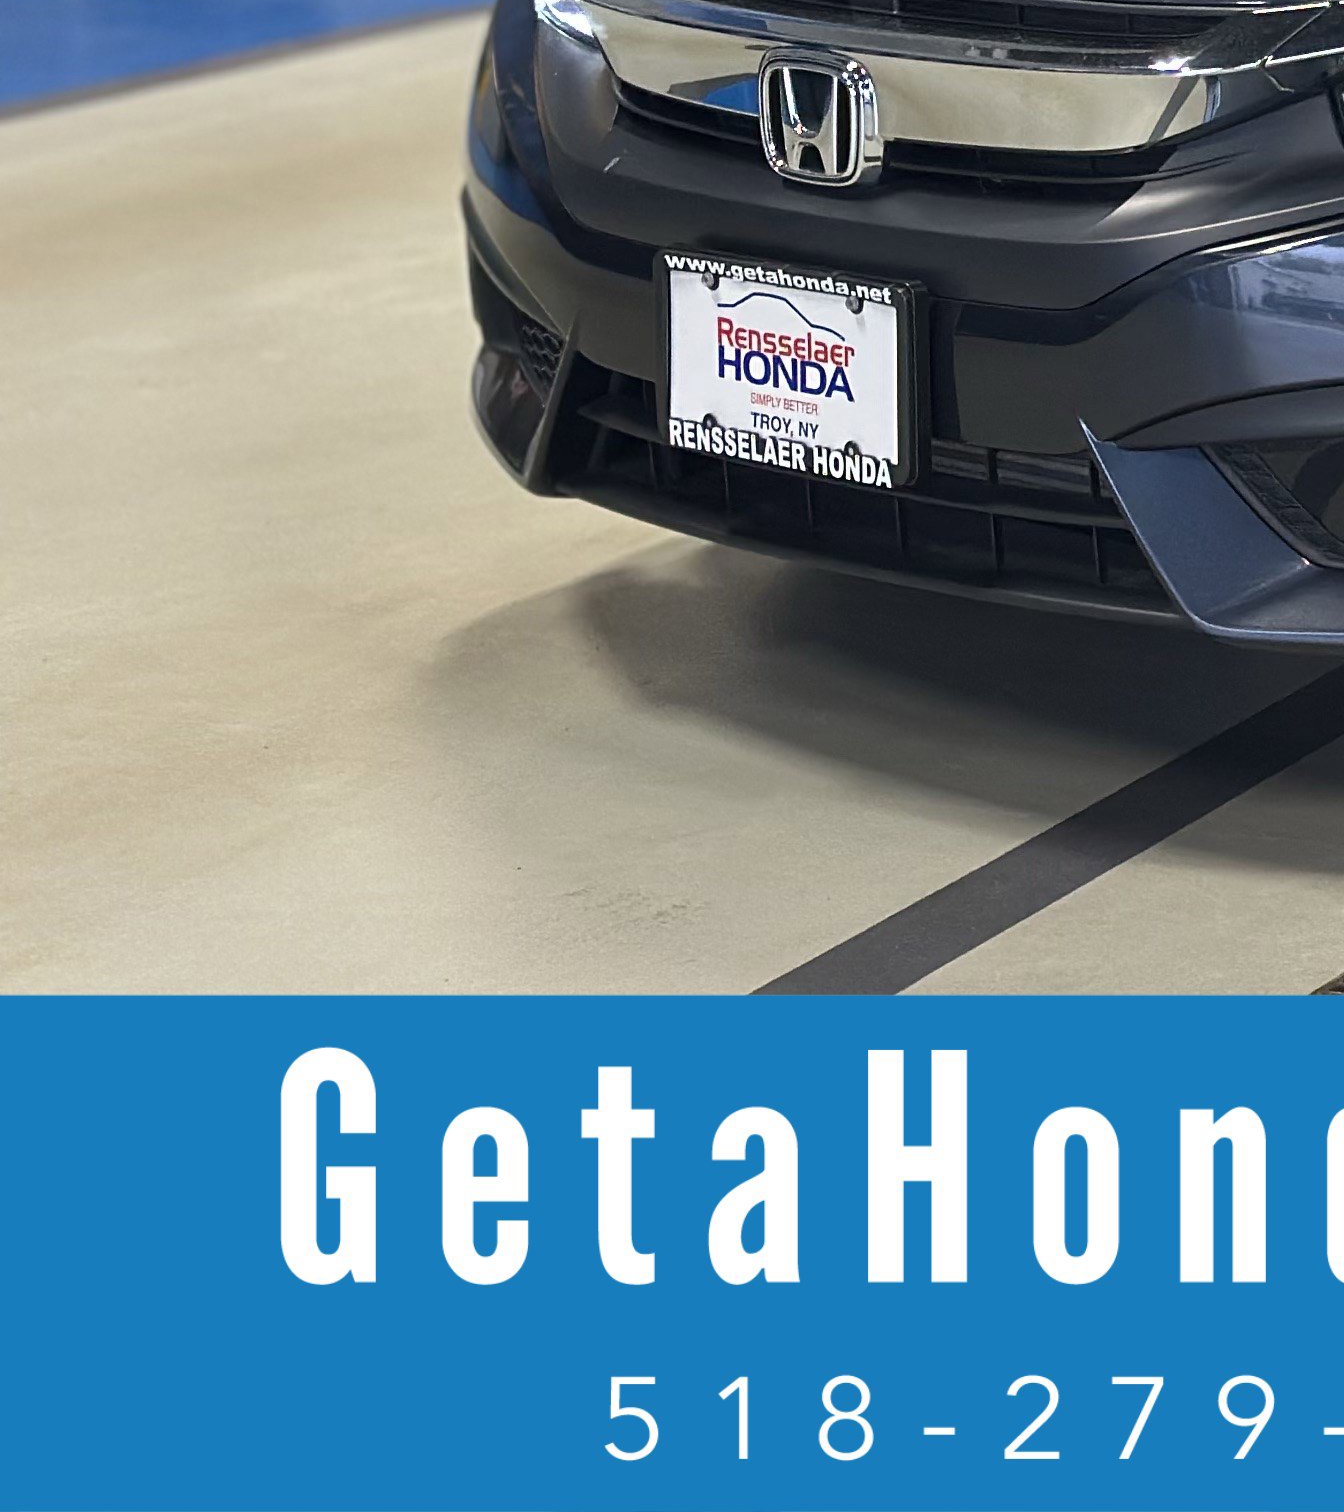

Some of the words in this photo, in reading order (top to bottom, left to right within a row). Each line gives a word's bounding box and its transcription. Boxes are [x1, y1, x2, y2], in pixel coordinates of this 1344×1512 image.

[664, 254, 892, 304] www.getahonda.net
[717, 317, 855, 368] Rensselaer
[718, 345, 855, 402] HONDA
[750, 392, 781, 409] SIMPLY
[783, 397, 818, 416] BETTER
[751, 412, 795, 436] TROY,
[799, 421, 819, 439] NY
[669, 419, 806, 471] RENSSELAER
[813, 446, 892, 488] HONDA
